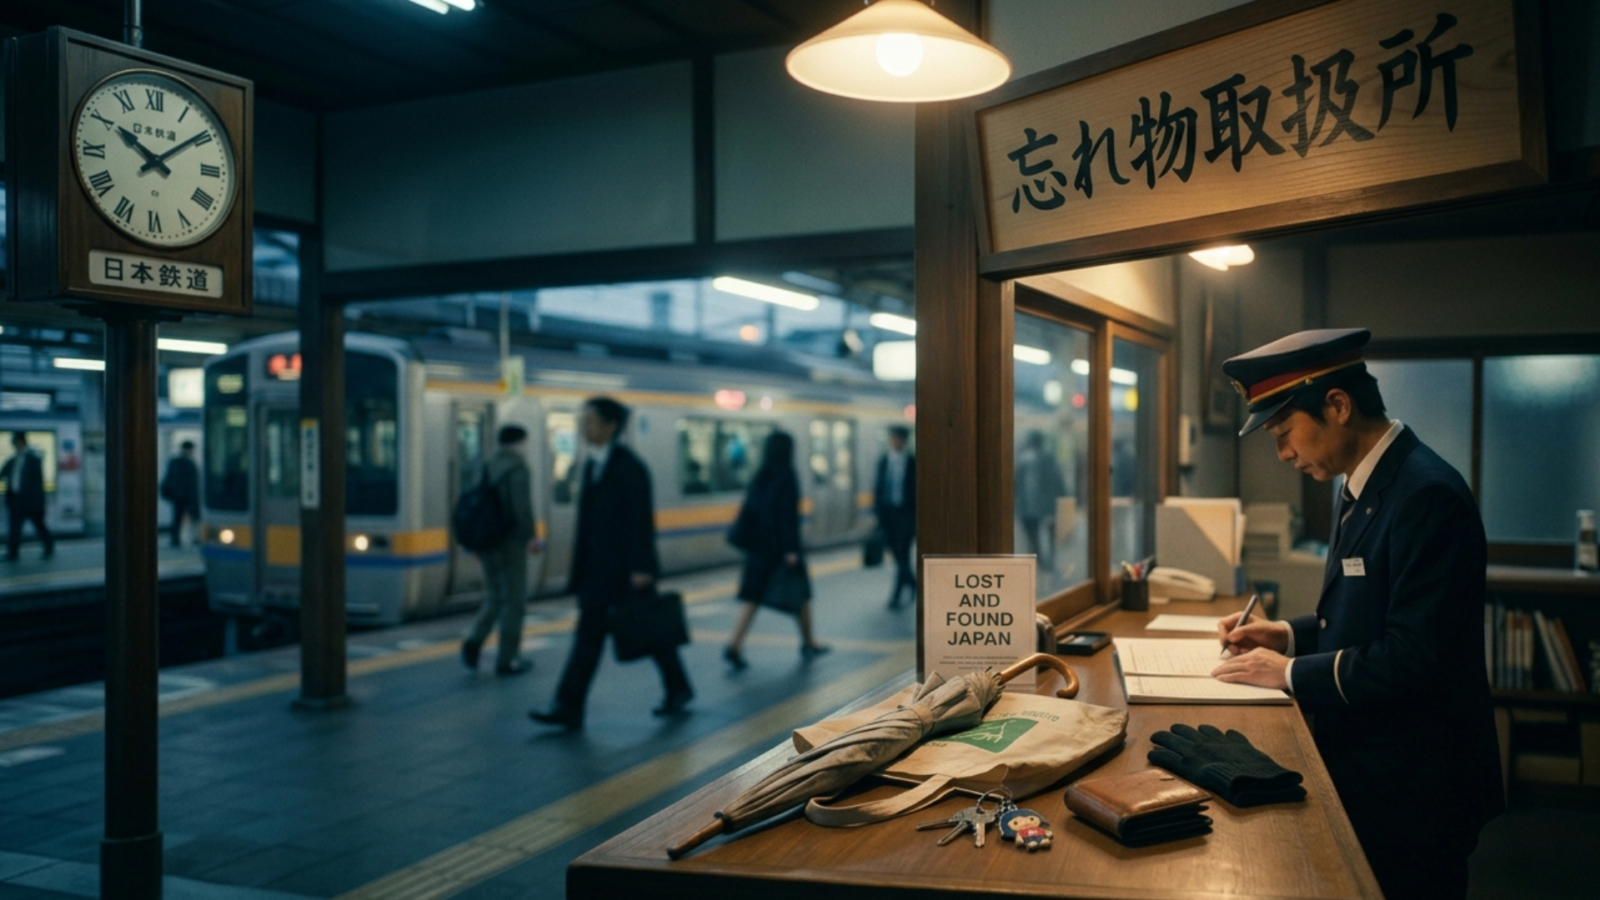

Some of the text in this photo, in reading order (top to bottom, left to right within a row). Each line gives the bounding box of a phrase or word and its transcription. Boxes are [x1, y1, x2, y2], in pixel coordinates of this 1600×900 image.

[112, 89, 135, 114] XI
[145, 88, 164, 113] XII
[90, 108, 114, 131] X
[1007, 12, 1474, 214] 忘れ物取扱所
[83, 140, 105, 159] IX
[200, 163, 220, 178] III
[105, 257, 209, 292] 日本鉄道
[955, 574, 1005, 589] LOST
[958, 593, 1000, 608] AND
[946, 612, 1014, 626] FOUND
[947, 631, 1011, 646] JAPAN
